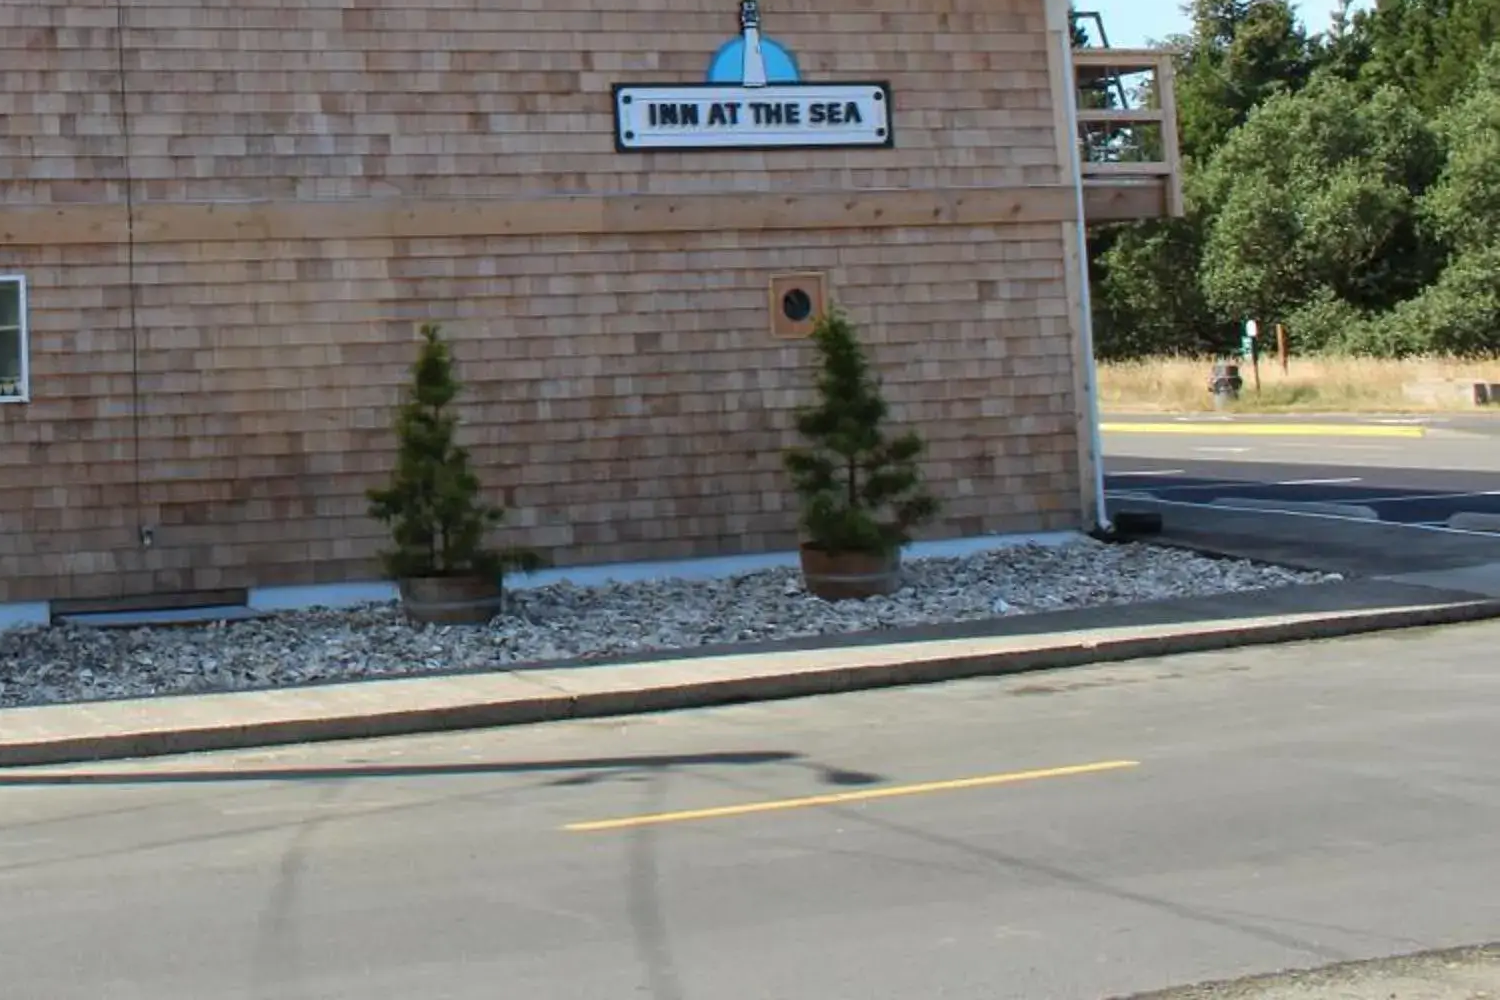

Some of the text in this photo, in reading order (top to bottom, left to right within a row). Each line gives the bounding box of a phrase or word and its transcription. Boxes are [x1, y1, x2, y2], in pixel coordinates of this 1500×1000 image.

[648, 101, 863, 126] INN AT THE SEA
